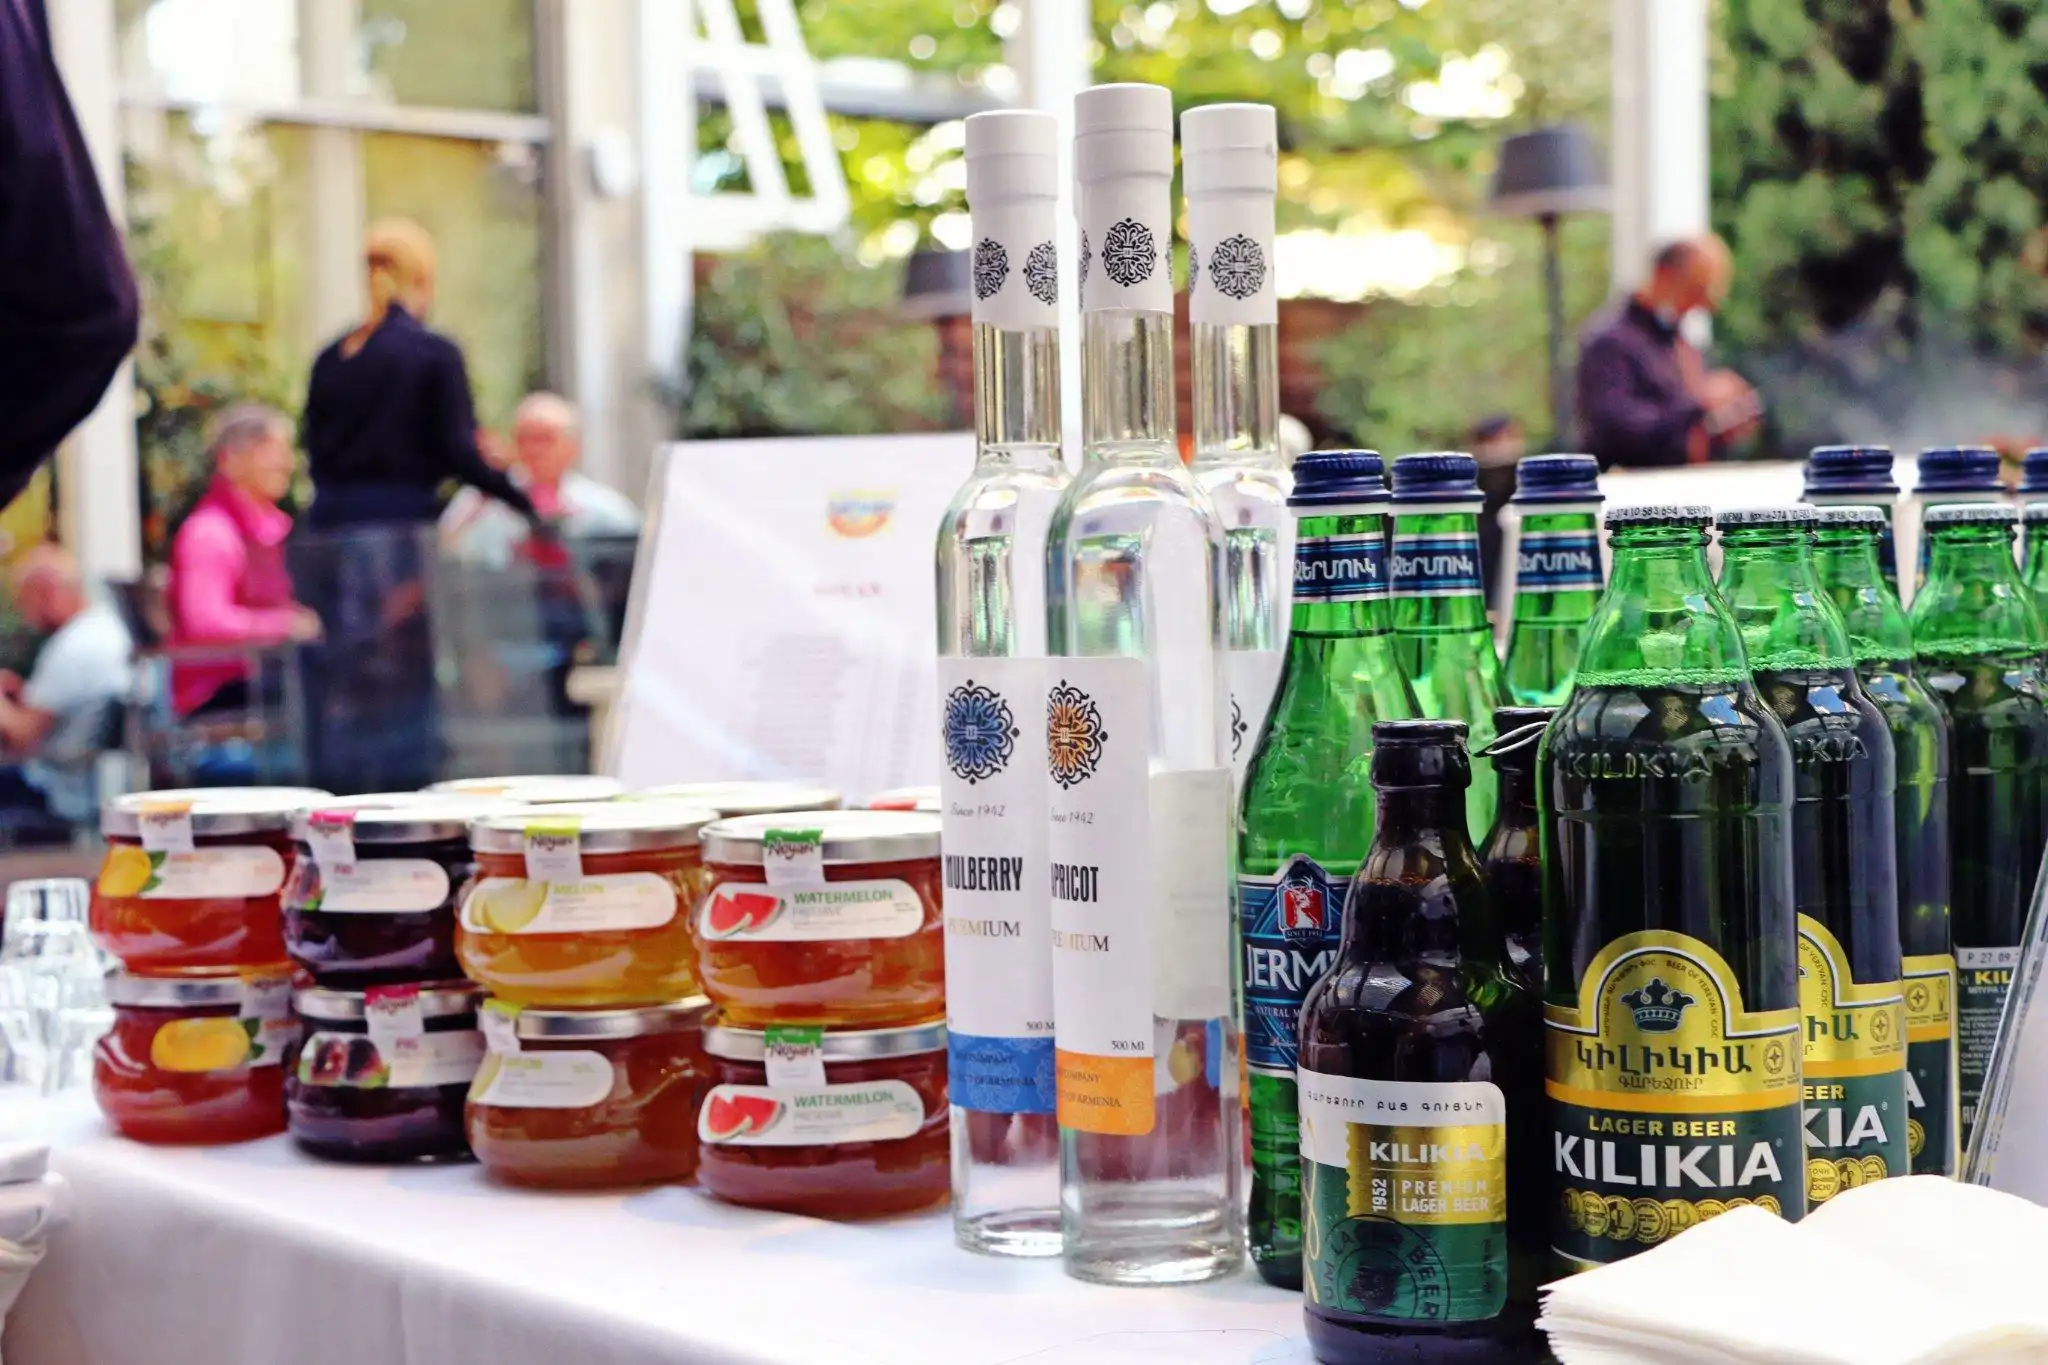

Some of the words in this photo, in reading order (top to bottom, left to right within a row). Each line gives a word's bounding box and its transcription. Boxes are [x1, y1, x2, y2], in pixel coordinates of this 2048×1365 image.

[977, 804, 1006, 818] 1942
[1069, 811, 1095, 825] 1942
[946, 853, 1024, 892] MULBERRY
[793, 889, 894, 905] WATERMELON
[1111, 1040, 1129, 1051] 500
[794, 1090, 895, 1108] WATERMELON
[1588, 1115, 1664, 1137] LAGER
[1672, 1120, 1737, 1137] BEER
[1369, 1141, 1485, 1164] KILIKIA
[1554, 1130, 1783, 1188] KILIKIA
[1371, 1178, 1388, 1212] 1952
[1401, 1179, 1488, 1195] PREMIUM
[1401, 1197, 1447, 1214] LAGER
[1453, 1197, 1490, 1213] BEER
